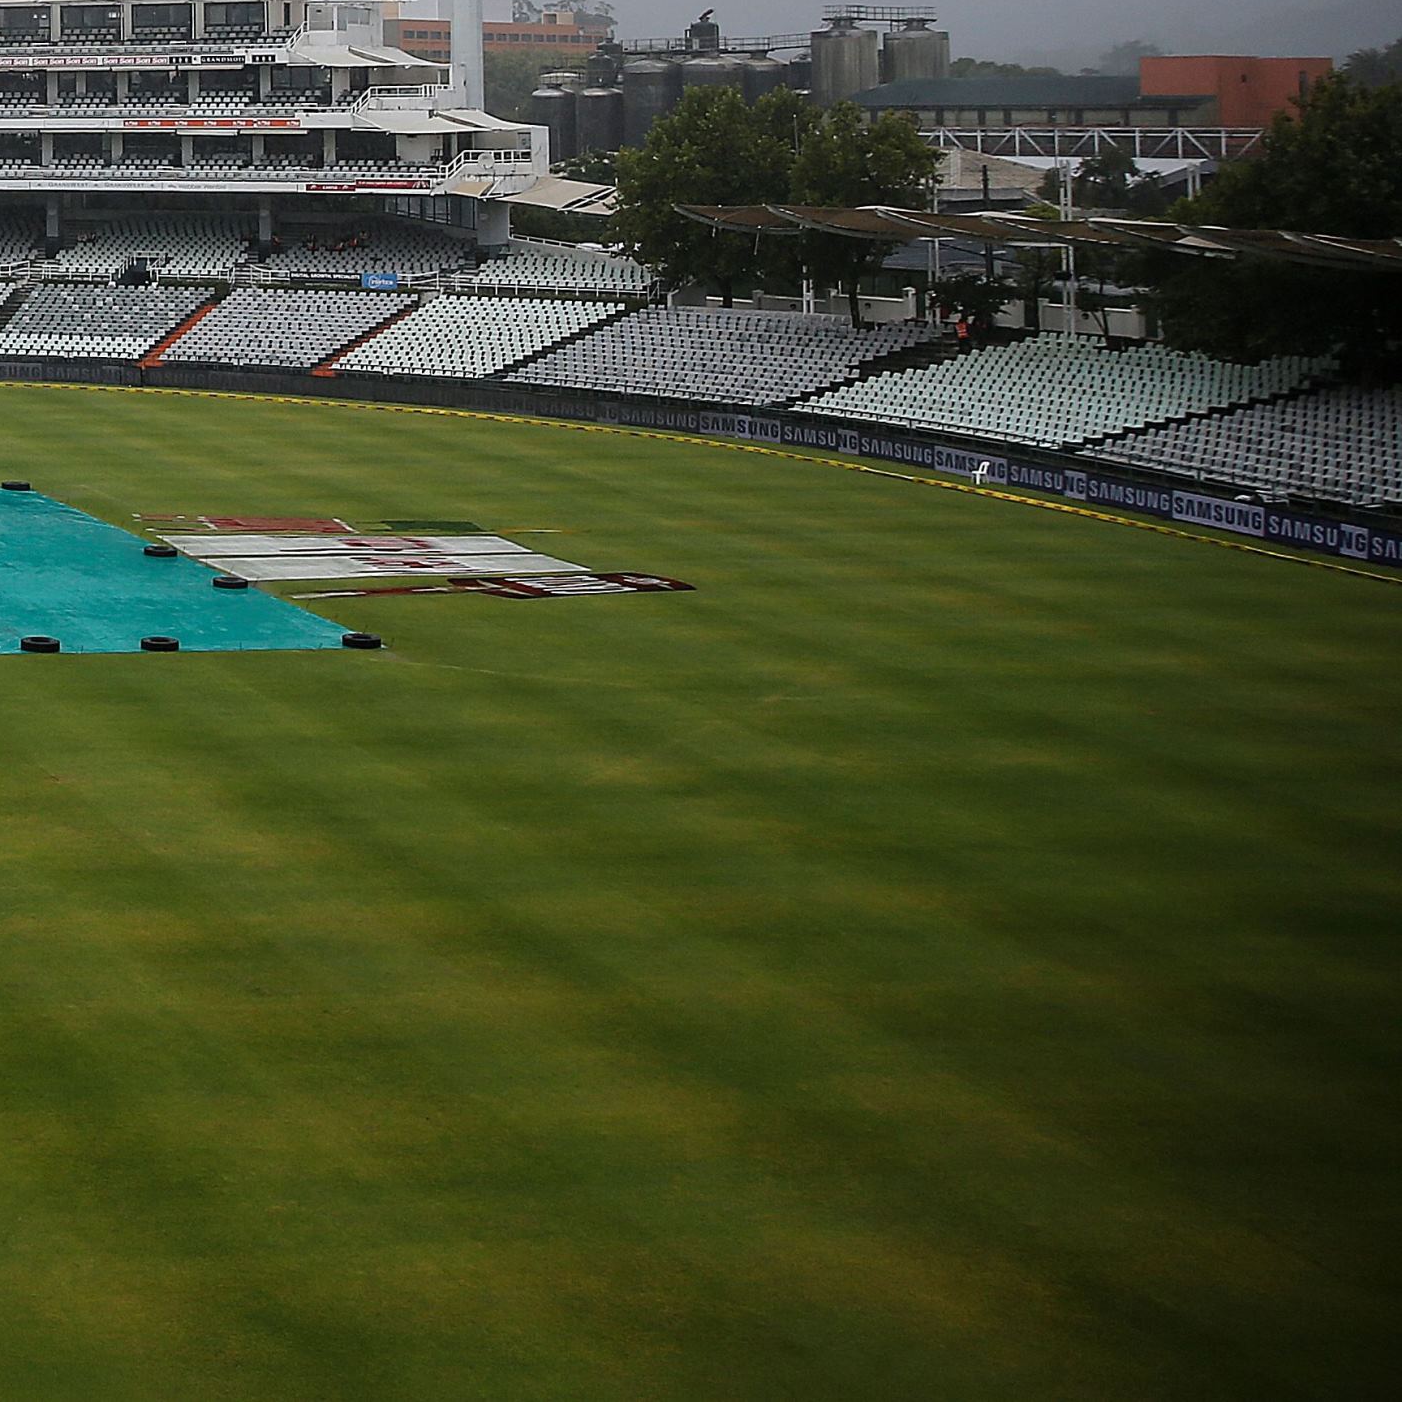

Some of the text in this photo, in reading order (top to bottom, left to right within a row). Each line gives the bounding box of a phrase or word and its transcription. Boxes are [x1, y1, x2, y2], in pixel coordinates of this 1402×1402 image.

[619, 408, 697, 428] SAMSUNG
[701, 414, 779, 438] SAMSUNG
[784, 426, 858, 450] SAMSUNG
[861, 437, 933, 463] SAMSUNG
[1010, 465, 1086, 495] SAMSUNG
[1088, 480, 1169, 511] SAMSUNG
[1174, 496, 1262, 530] SAMSUNG
[1268, 515, 1368, 553] SAMSUNG
